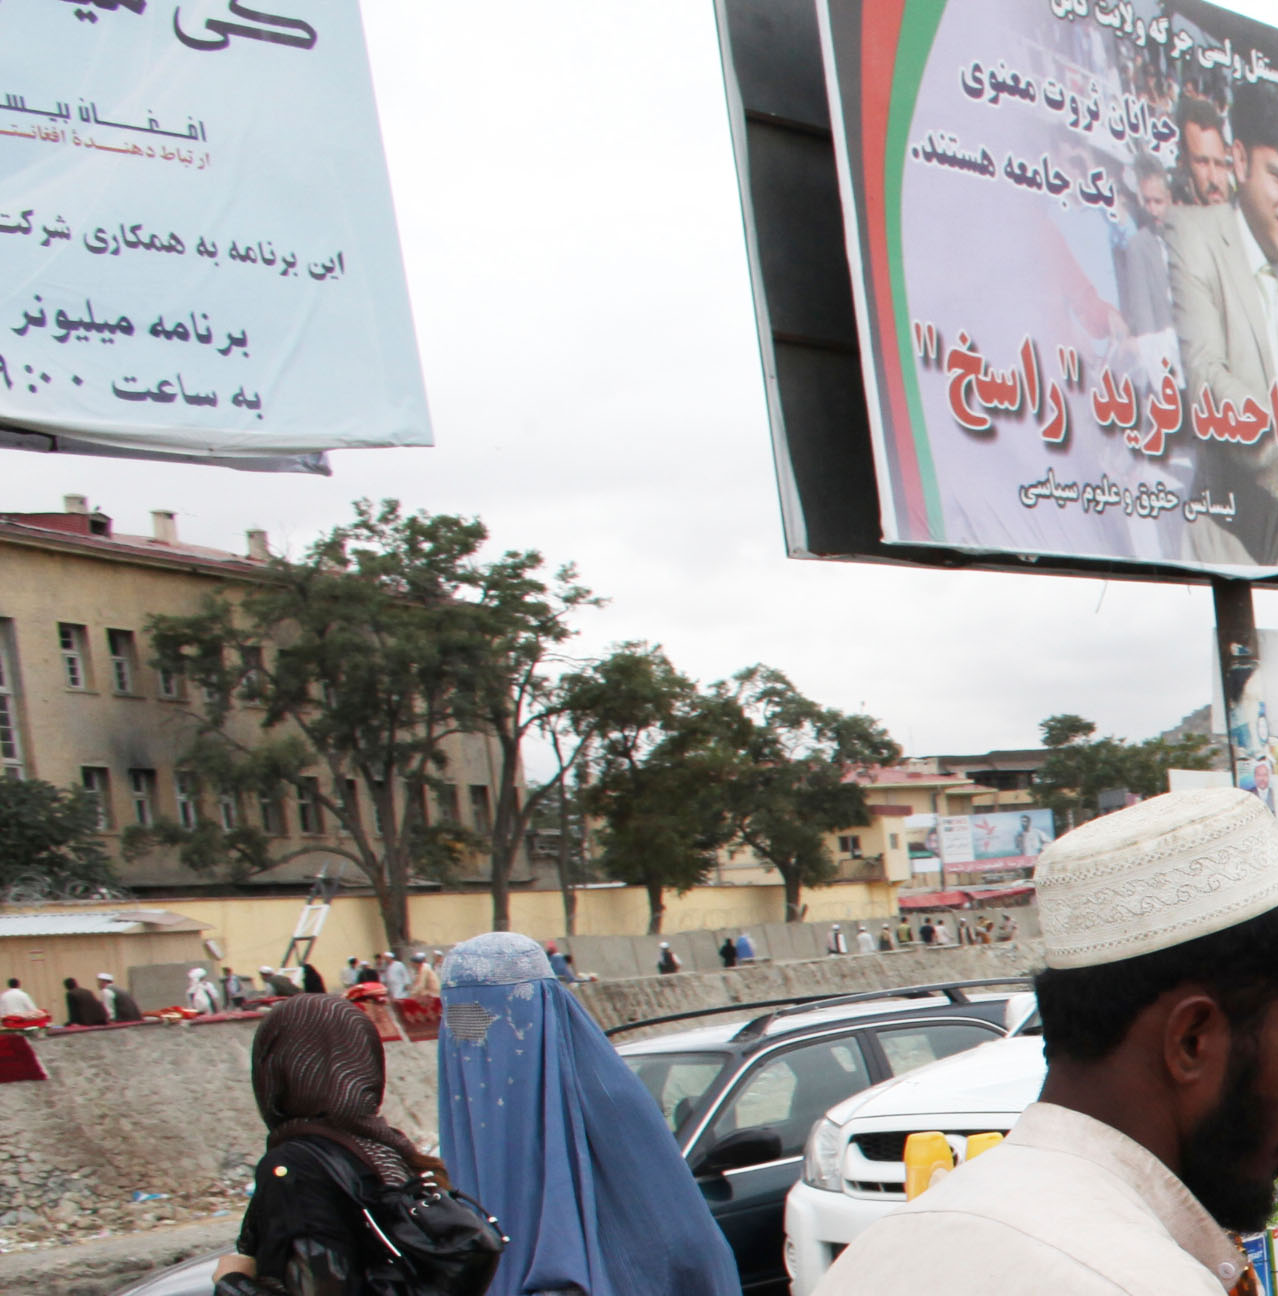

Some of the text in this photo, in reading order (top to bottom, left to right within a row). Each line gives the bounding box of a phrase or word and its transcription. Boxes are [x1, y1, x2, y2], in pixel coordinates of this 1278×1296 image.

[1150, 17, 1194, 60] جرگه
[1198, 39, 1242, 80] ولسی
[0, 93, 71, 124] بیس
[961, 62, 1180, 156] جوانان ثروت معنوی
[0, 124, 66, 143] افغانست
[160, 146, 211, 170] ارتباط
[912, 133, 1118, 219] یک جامعه هستند.
[83, 223, 186, 256] همکاری
[197, 240, 220, 266] به
[229, 238, 299, 278] برنامه
[307, 251, 344, 281] این
[11, 294, 249, 357] برنامه میلیونر
[112, 372, 219, 408] ساعت
[231, 386, 264, 420] به
[1092, 357, 1184, 454] فرید
[1019, 467, 1237, 522] لیسانس حقوق و علوم سیاسی
